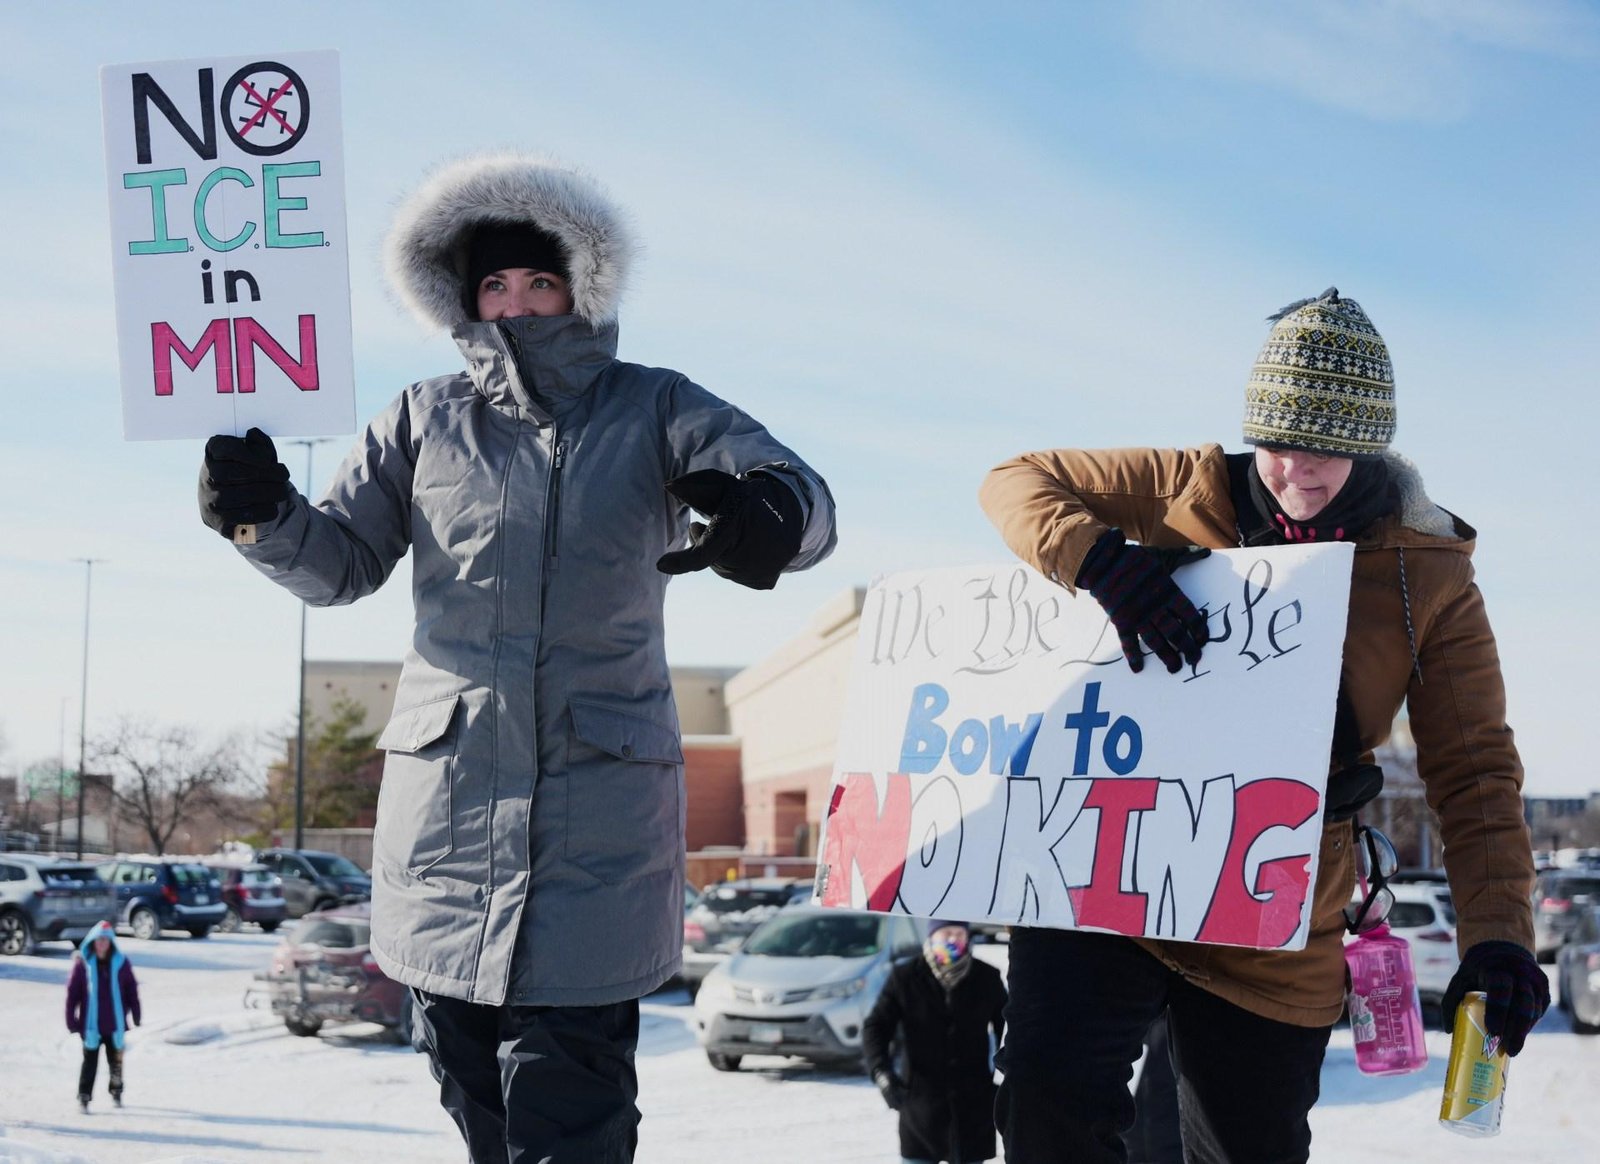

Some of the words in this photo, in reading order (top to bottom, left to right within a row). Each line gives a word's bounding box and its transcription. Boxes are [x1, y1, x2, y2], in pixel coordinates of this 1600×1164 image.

[132, 61, 311, 164] NO
[123, 161, 331, 255] I.C.E.
[201, 259, 261, 304] in
[150, 314, 320, 396] MN
[870, 577, 945, 666] We
[953, 568, 1058, 675] The
[899, 682, 1044, 776] Bow
[1064, 681, 1142, 776] to
[820, 771, 964, 917] NO
[987, 773, 1320, 948] KING
